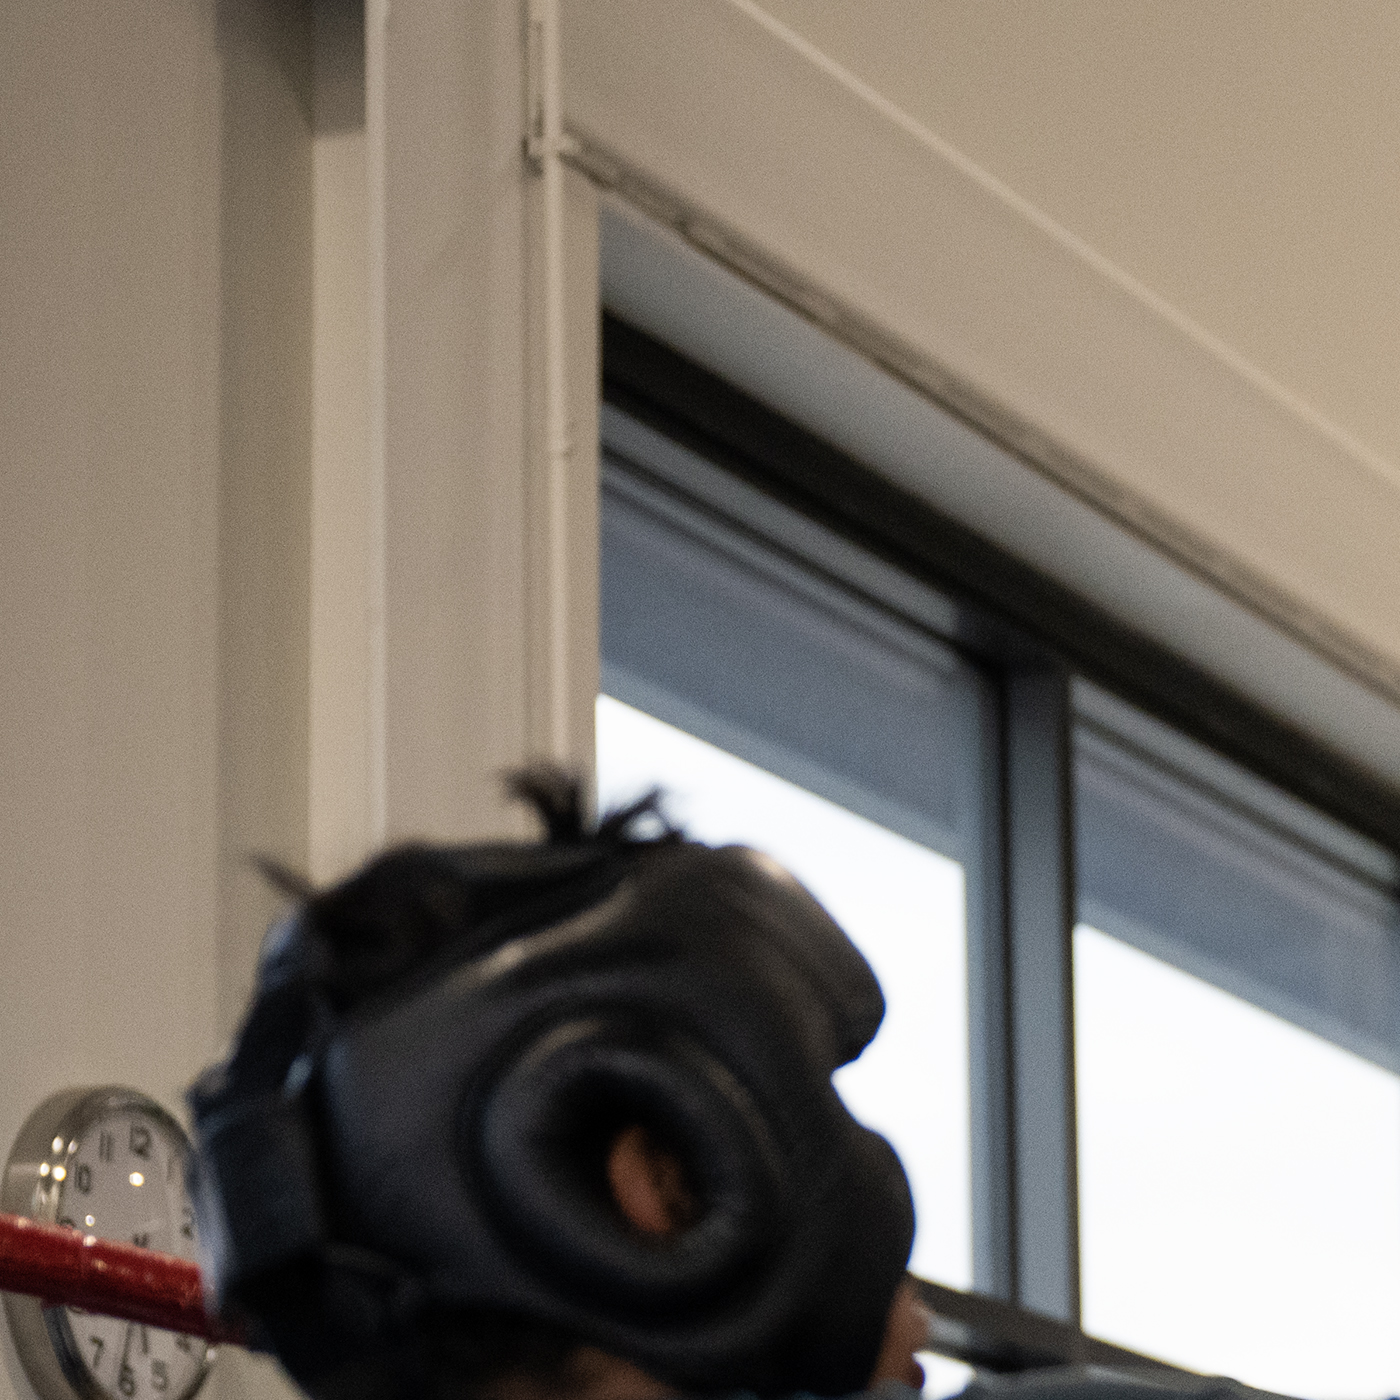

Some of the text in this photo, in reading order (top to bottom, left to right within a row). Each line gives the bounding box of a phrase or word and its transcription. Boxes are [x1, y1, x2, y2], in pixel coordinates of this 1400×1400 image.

[129, 1122, 152, 1160] 12
[74, 1161, 92, 1193] 10
[89, 1335, 104, 1368] 7
[118, 1362, 135, 1397] 6
